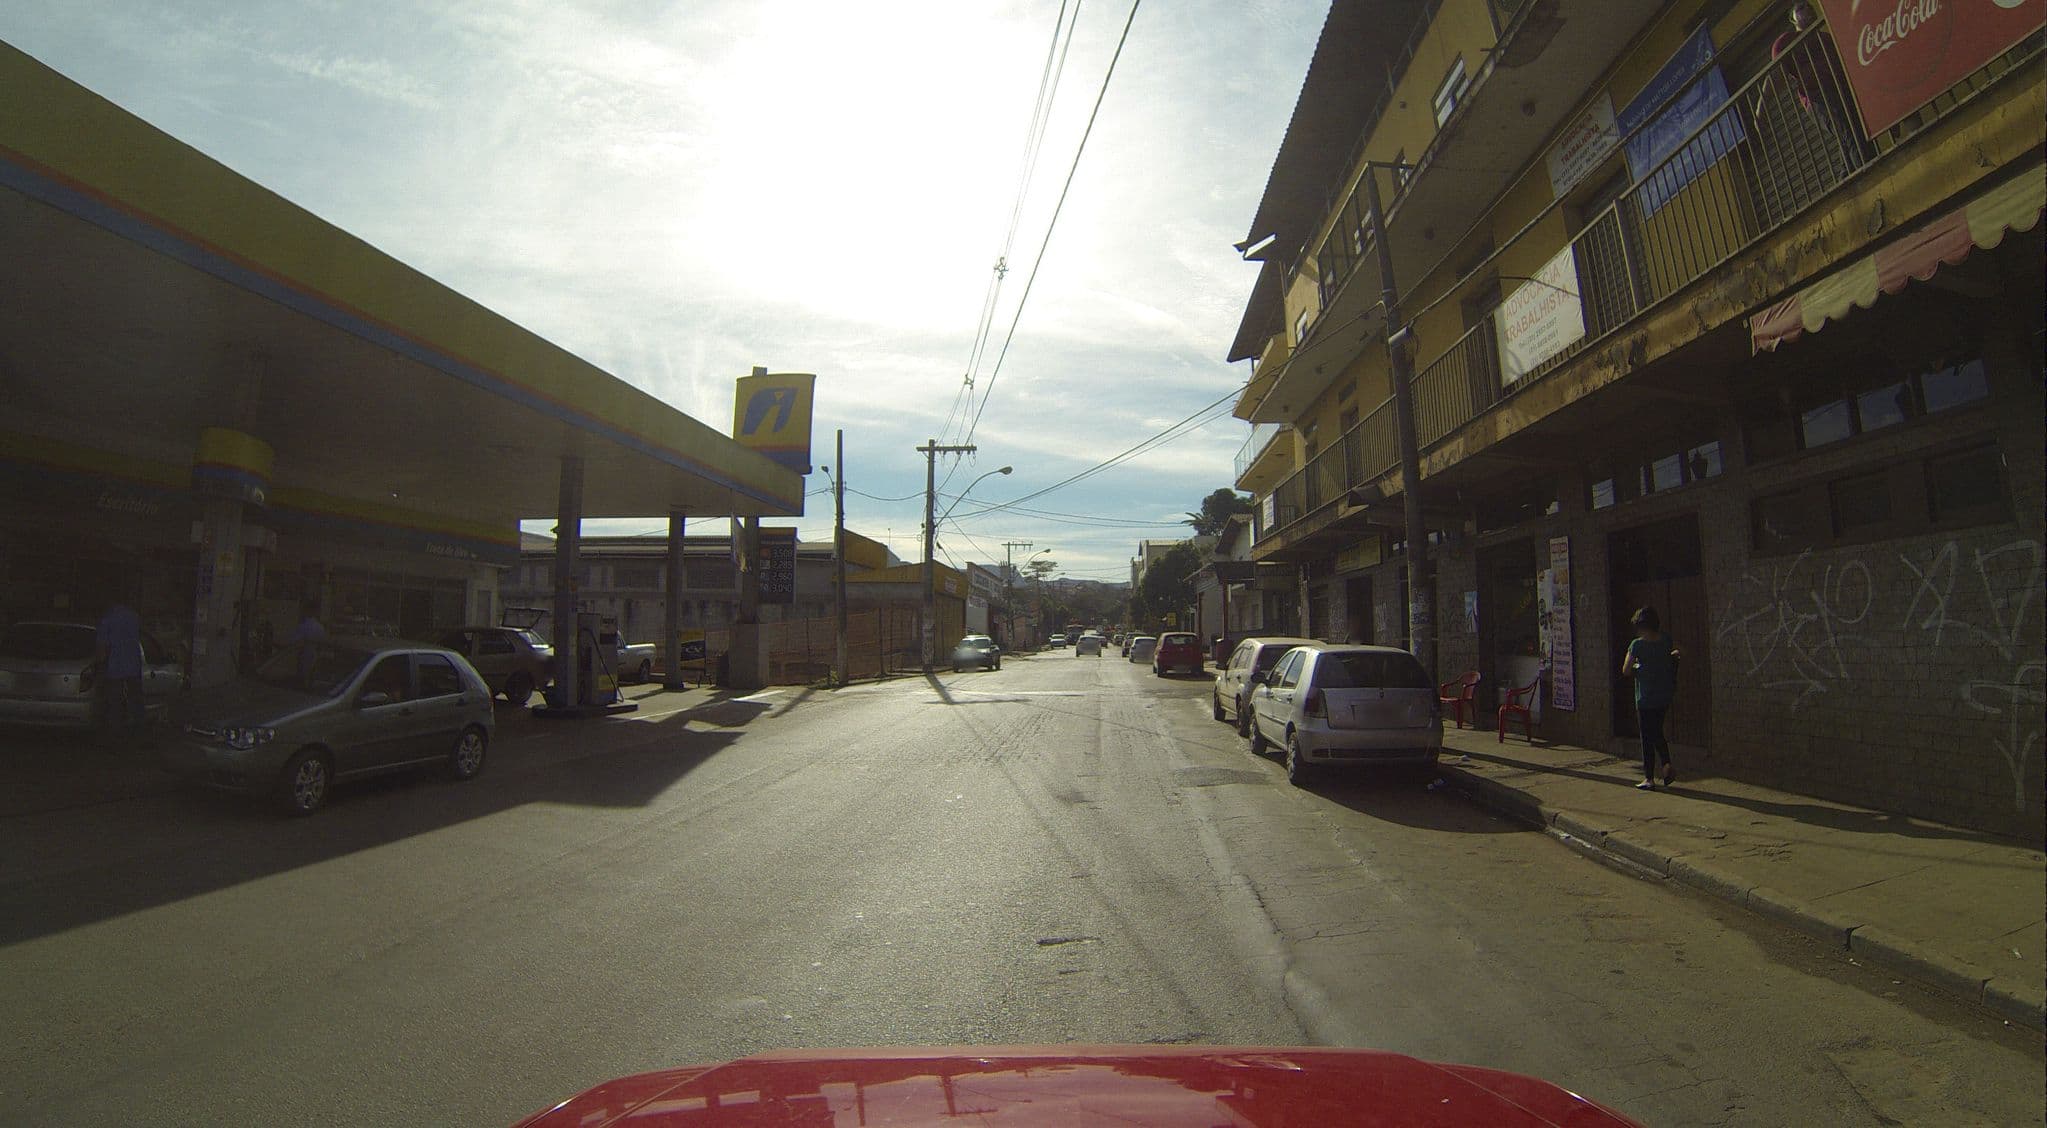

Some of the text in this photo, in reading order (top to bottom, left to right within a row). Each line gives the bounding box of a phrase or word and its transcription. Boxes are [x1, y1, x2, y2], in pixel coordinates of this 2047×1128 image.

[1857, 0, 1939, 66] Coca-Cola
[1503, 287, 1569, 344] TRABALHISTA
[1506, 263, 1560, 320] ADVOCACIA
